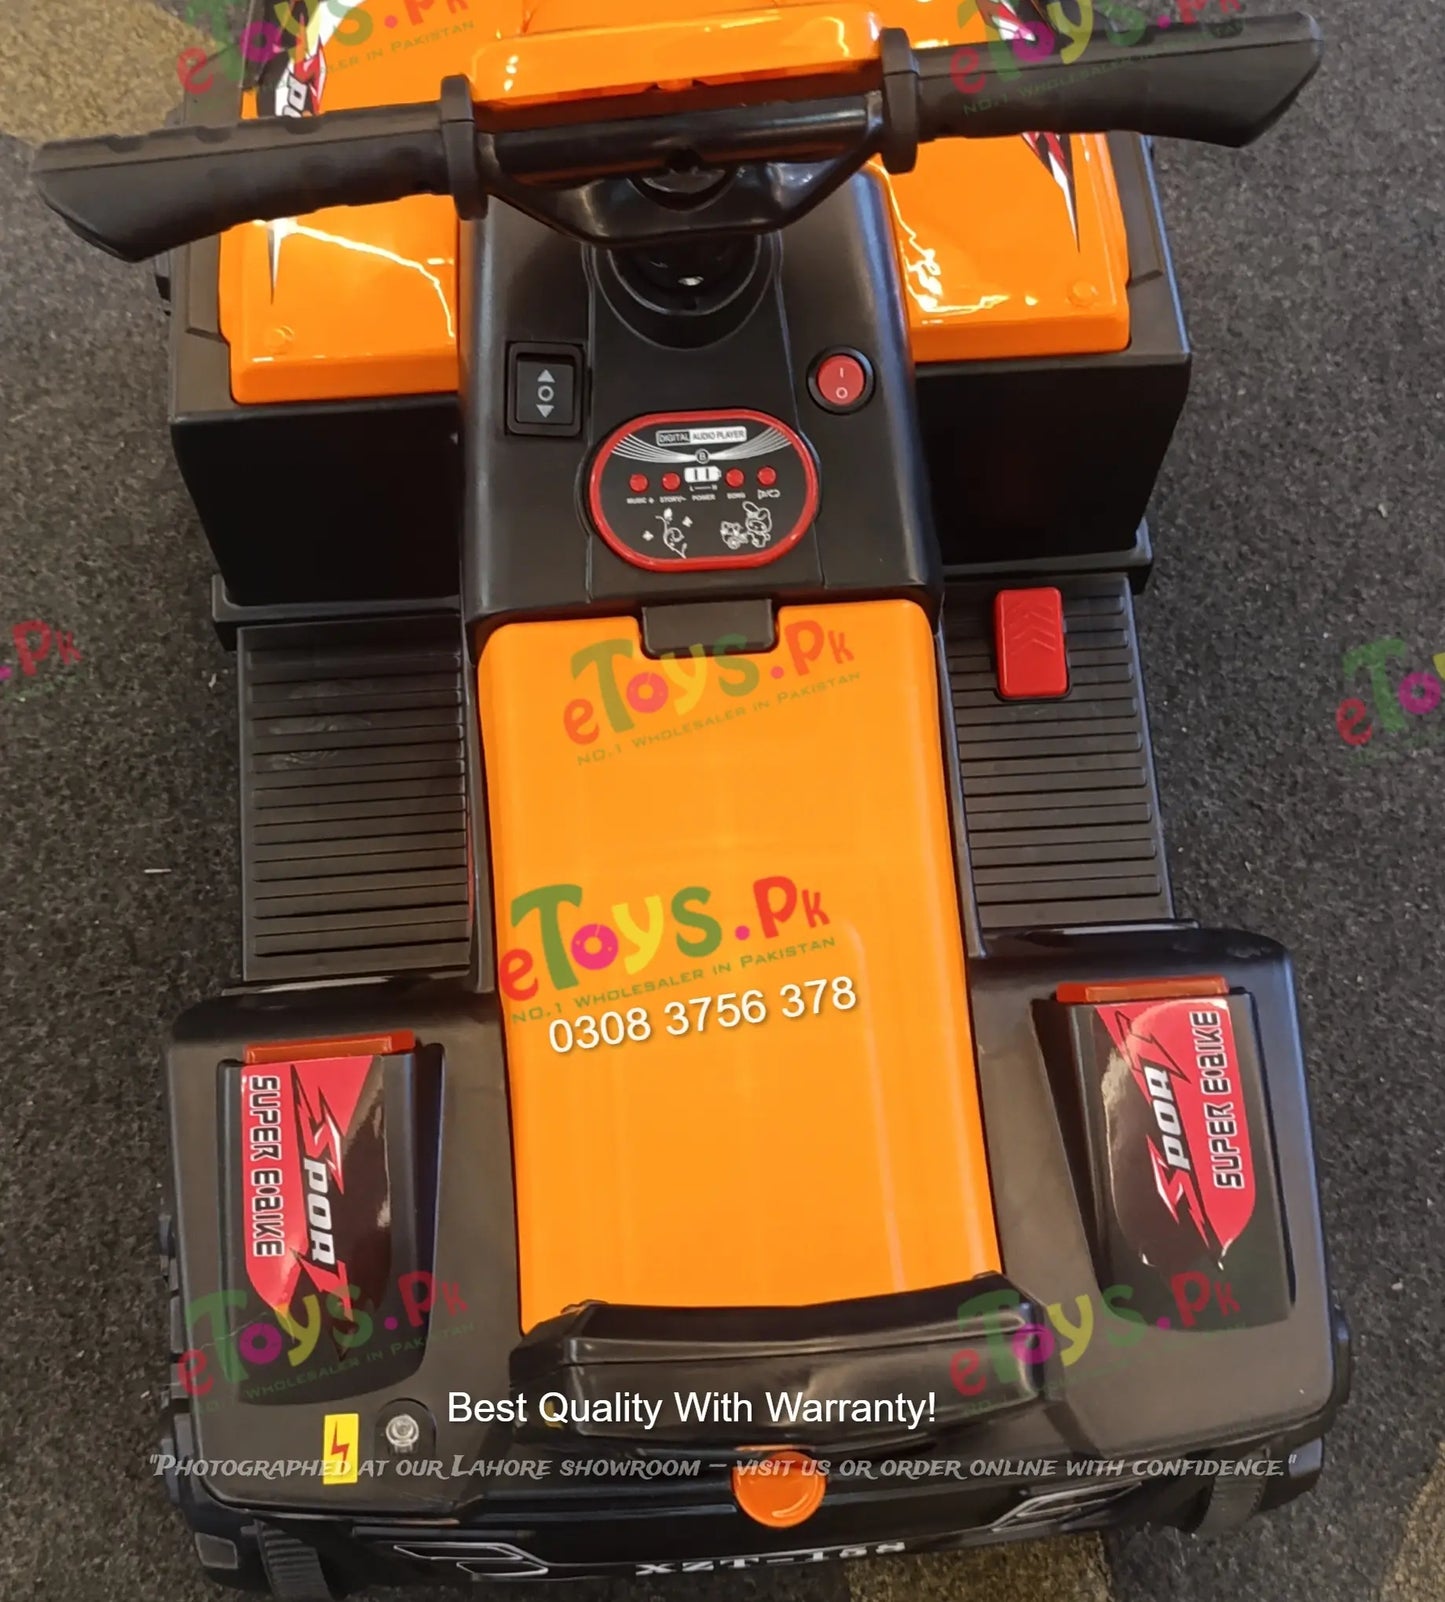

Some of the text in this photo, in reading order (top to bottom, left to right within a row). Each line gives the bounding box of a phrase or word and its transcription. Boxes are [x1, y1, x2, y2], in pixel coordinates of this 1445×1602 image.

[658, 429, 745, 443] DIGITAL AUDIO PLAYER
[691, 493, 716, 501] POWER
[250, 1075, 282, 1160] SUPER
[1204, 1102, 1245, 1189] SUPER
